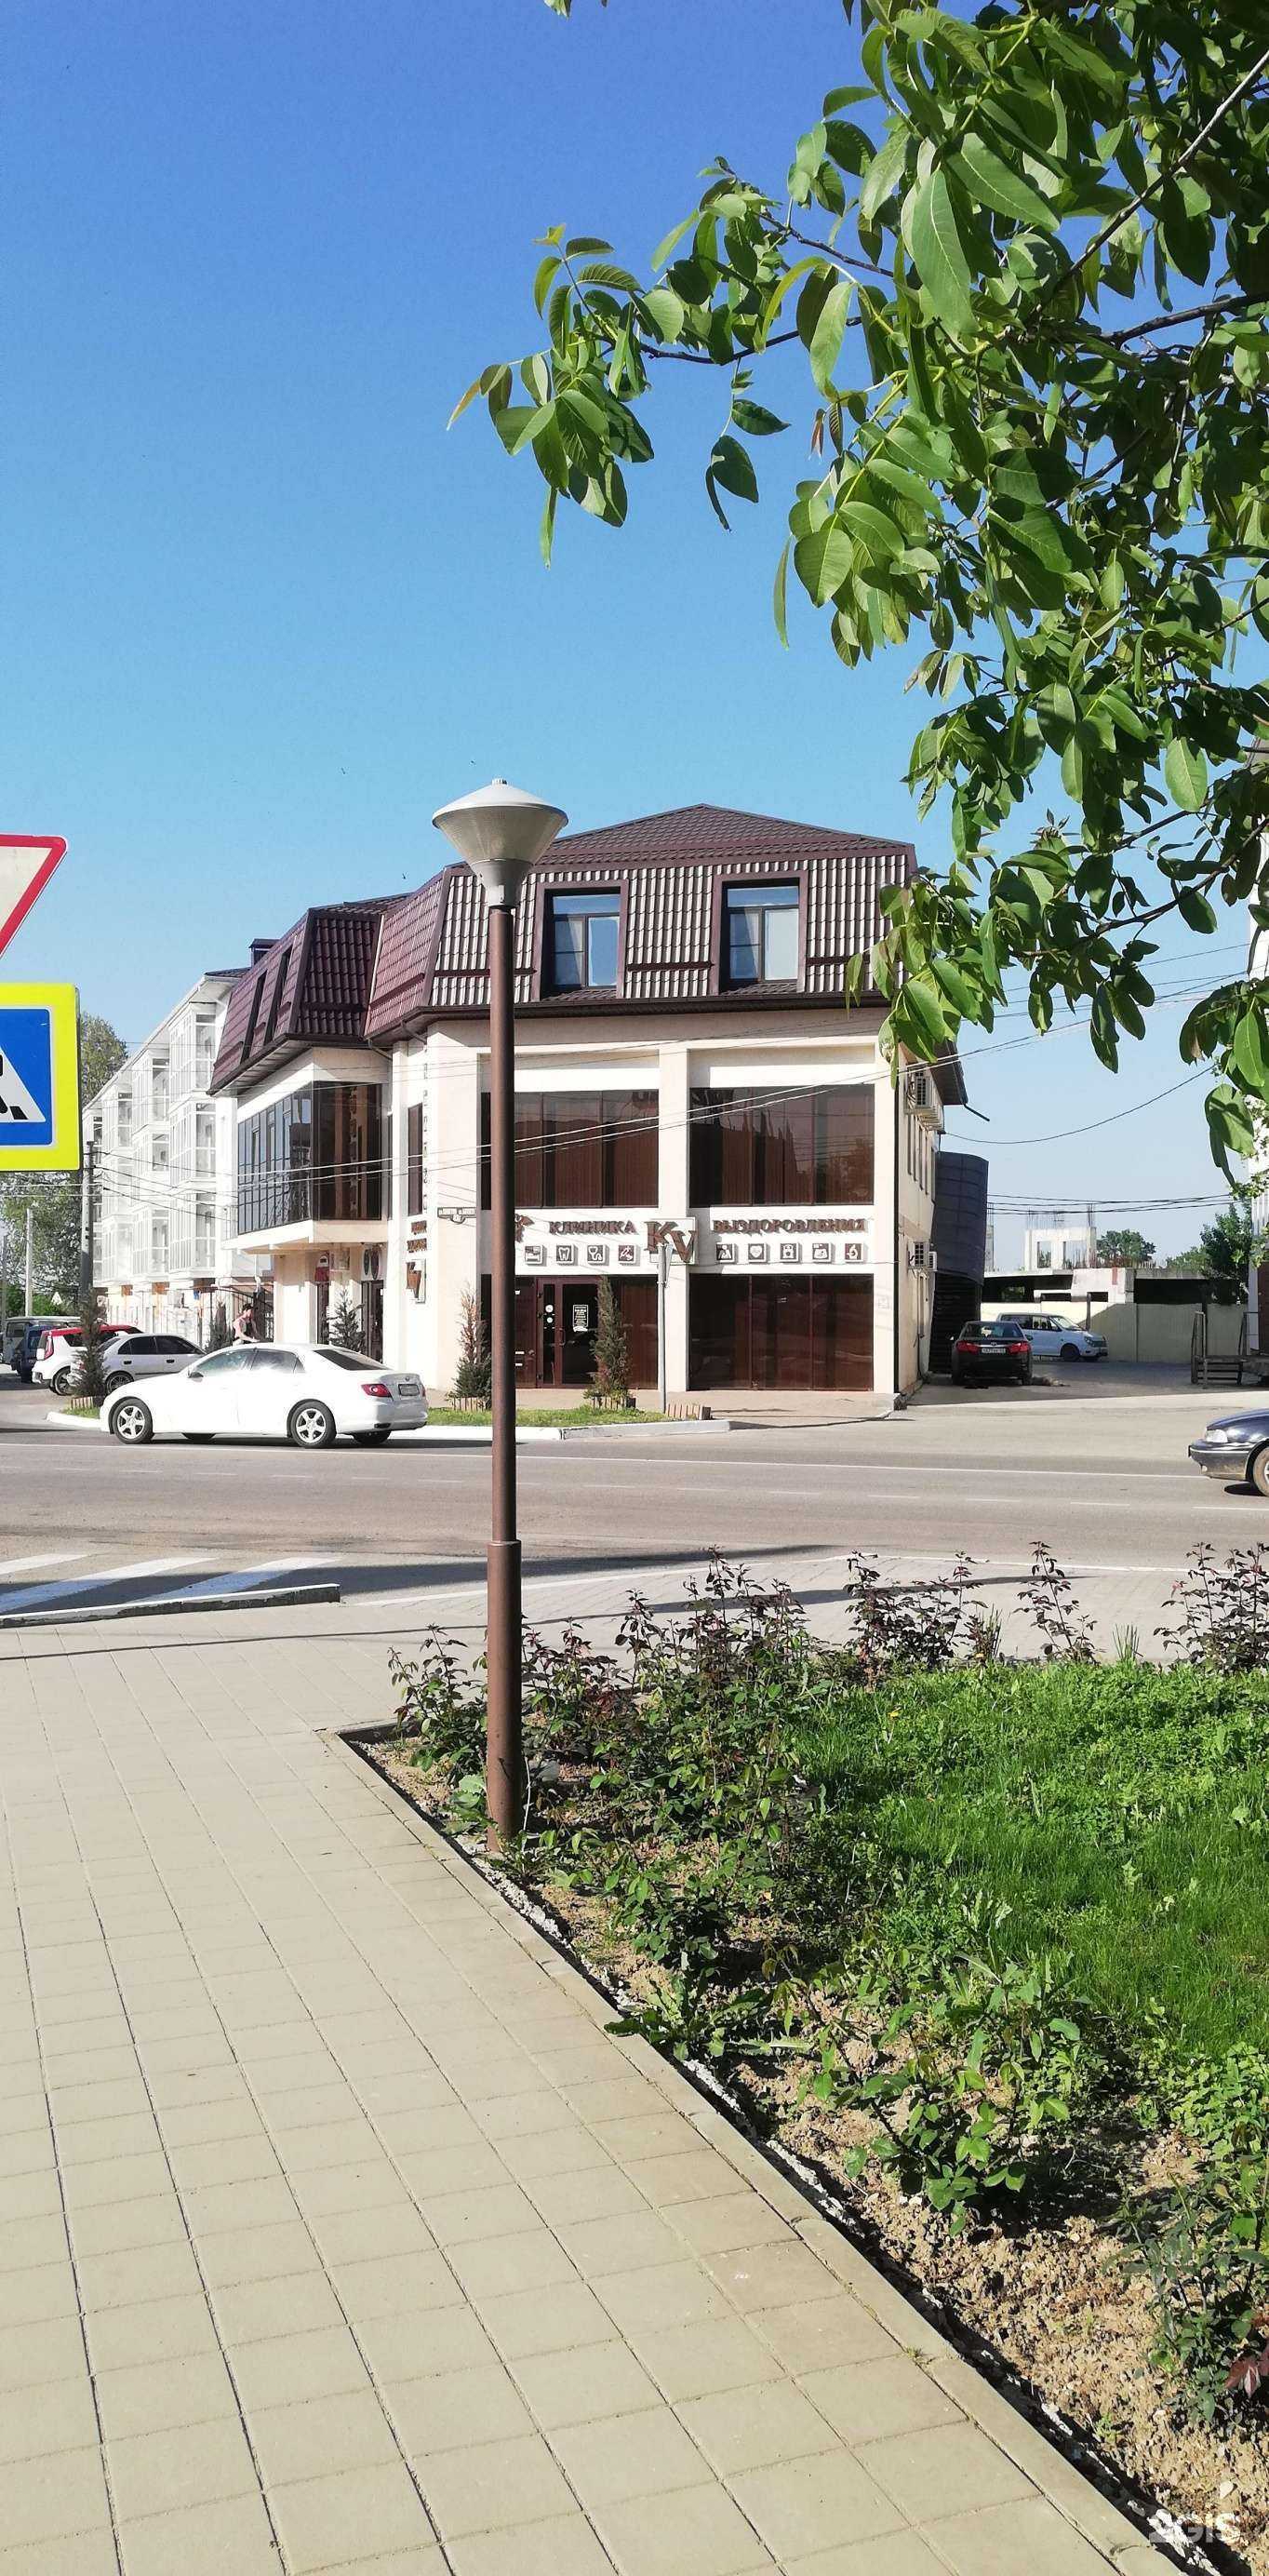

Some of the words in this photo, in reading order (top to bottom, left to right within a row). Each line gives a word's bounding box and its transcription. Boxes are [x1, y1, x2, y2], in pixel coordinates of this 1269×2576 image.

[549, 1220, 638, 1235] КЛИНИКА
[713, 1218, 866, 1235] ВЫЗДОРОВЛЕНИЯ
[644, 1221, 697, 1263] KV
